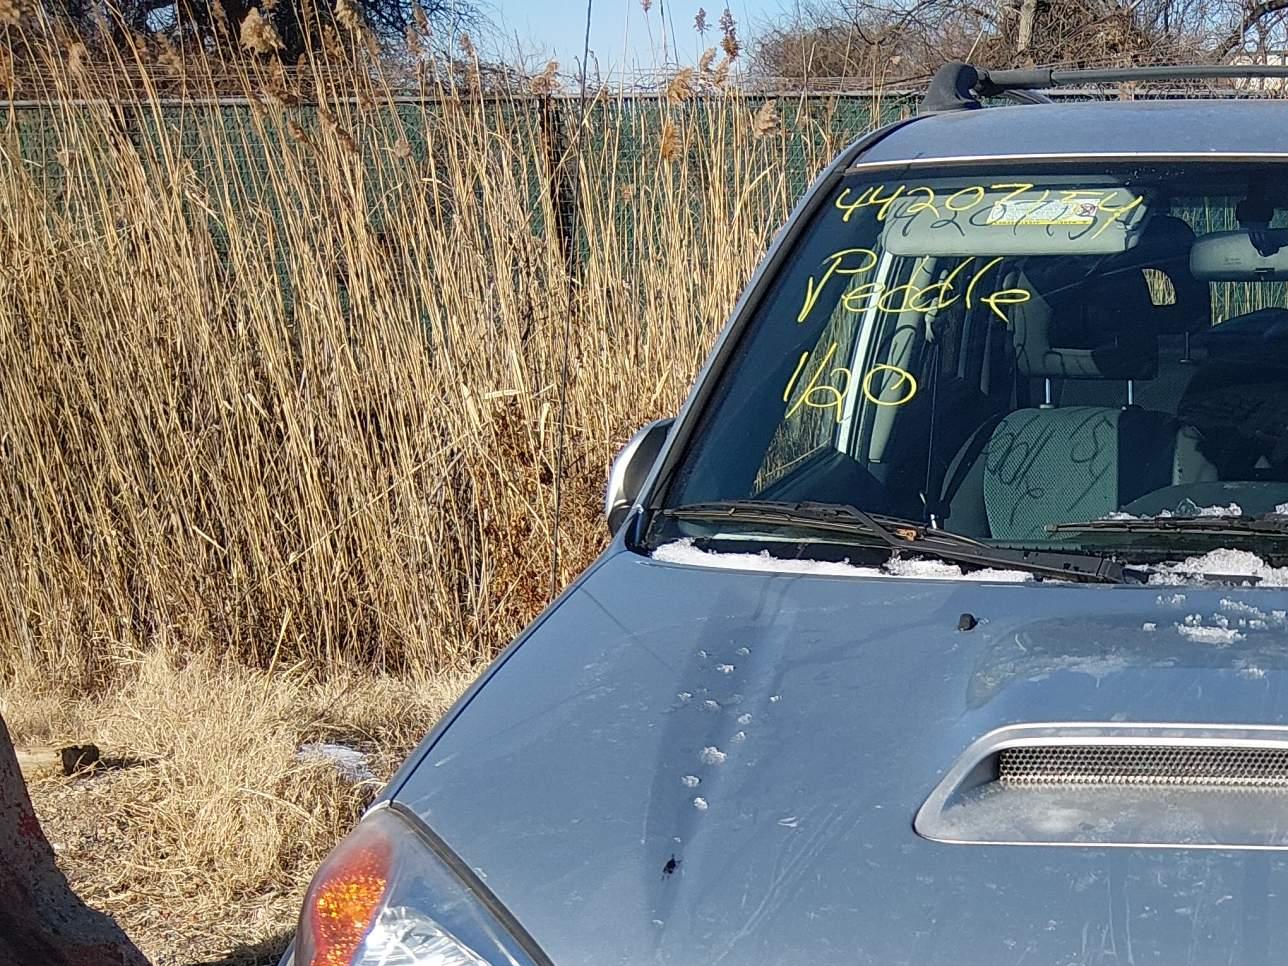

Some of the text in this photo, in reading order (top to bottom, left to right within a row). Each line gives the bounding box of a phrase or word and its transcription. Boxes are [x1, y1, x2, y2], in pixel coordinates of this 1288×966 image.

[835, 183, 1144, 240] 44207154
[797, 248, 1031, 323] Peddle
[783, 342, 918, 424] 1/20
